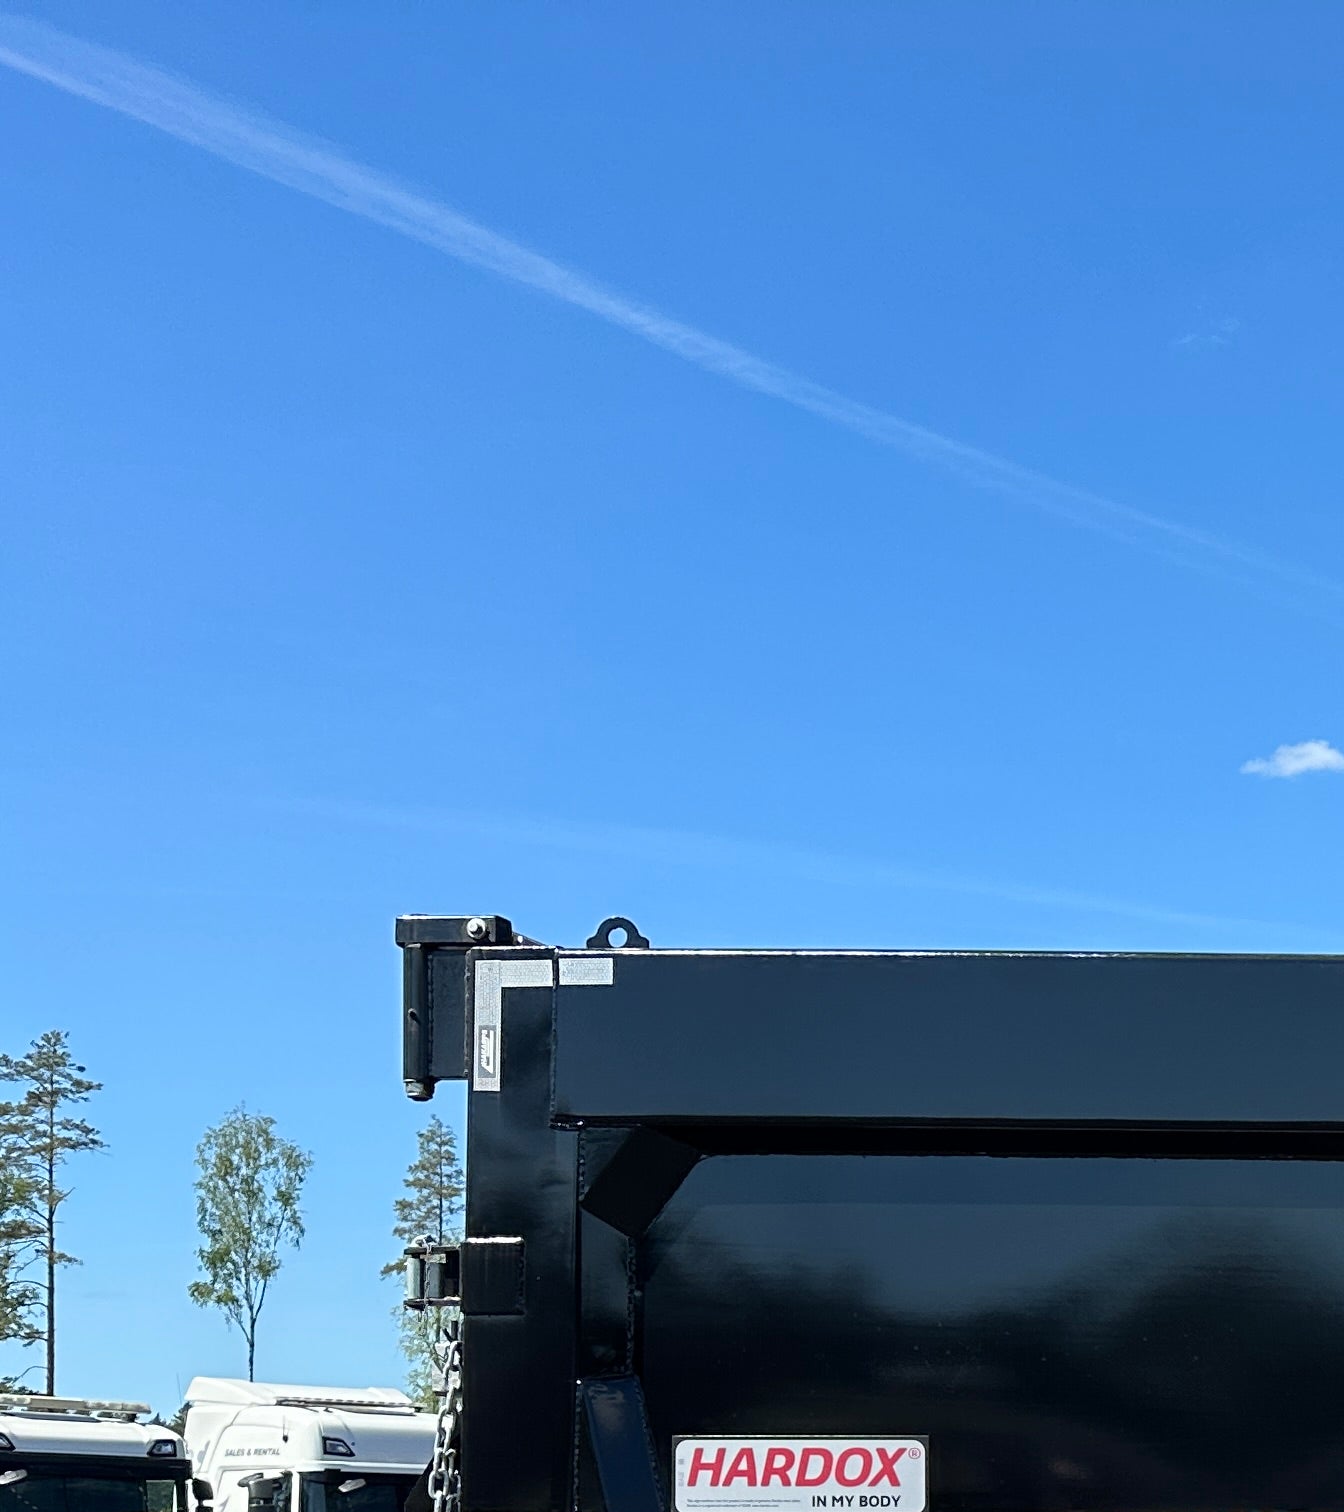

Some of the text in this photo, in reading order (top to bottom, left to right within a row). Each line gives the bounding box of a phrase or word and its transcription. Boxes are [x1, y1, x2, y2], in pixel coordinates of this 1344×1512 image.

[224, 1448, 245, 1457] SALES
[253, 1447, 280, 1456] RENTAL
[812, 1495, 827, 1507] IN
[831, 1495, 856, 1507] MY
[859, 1495, 901, 1507] BODY
